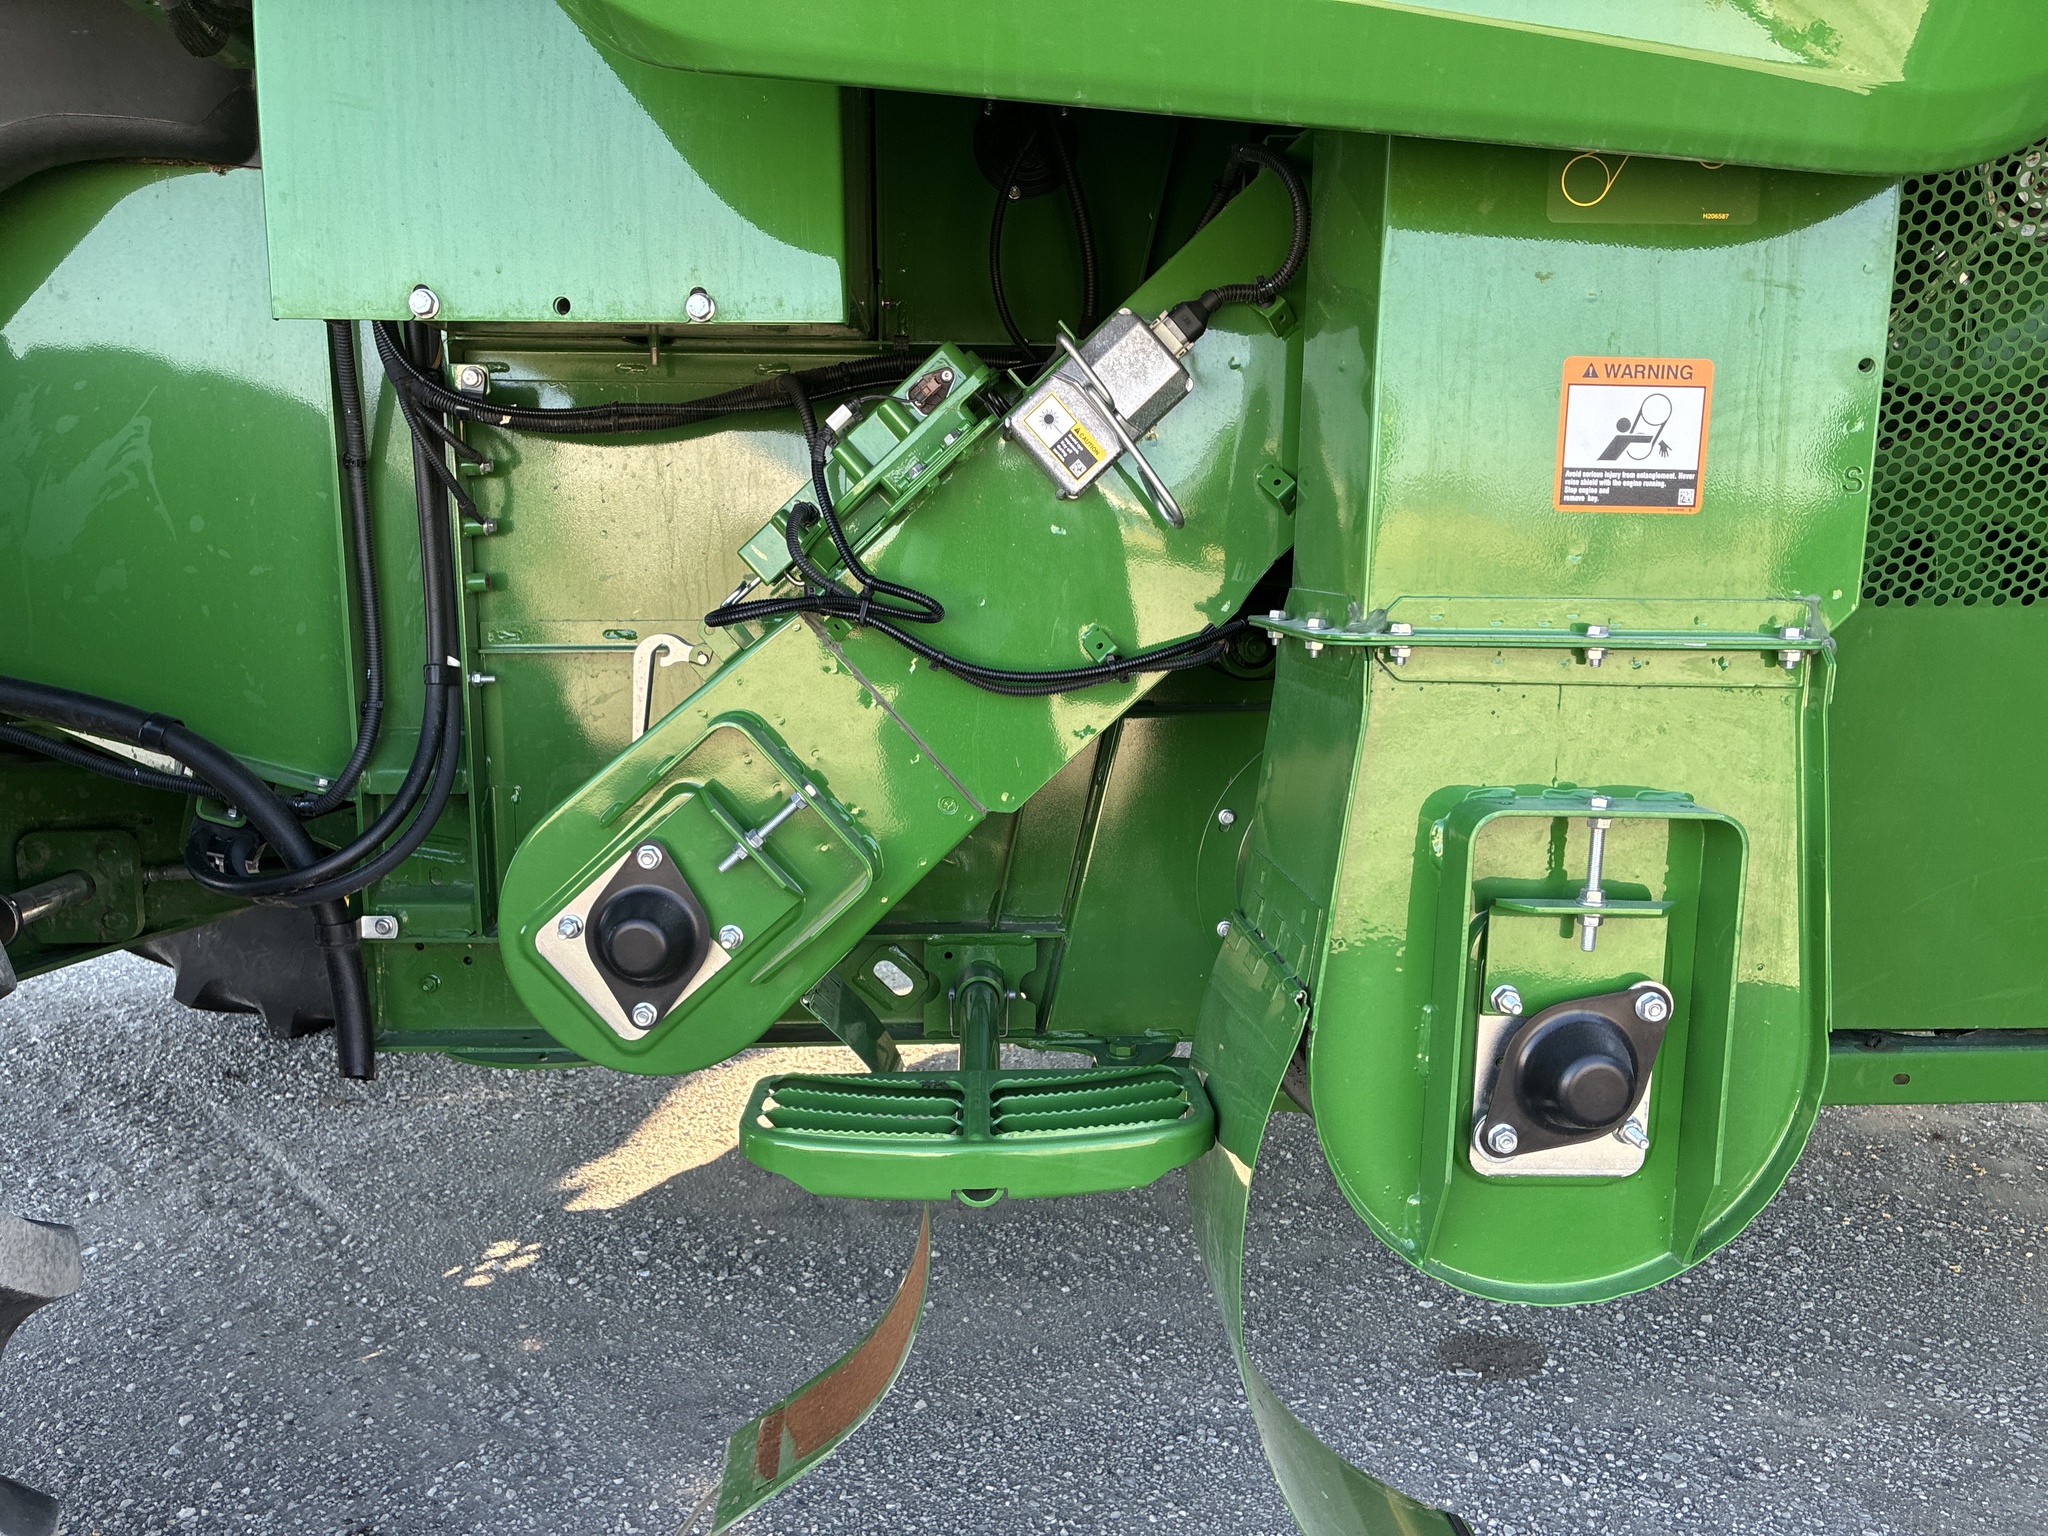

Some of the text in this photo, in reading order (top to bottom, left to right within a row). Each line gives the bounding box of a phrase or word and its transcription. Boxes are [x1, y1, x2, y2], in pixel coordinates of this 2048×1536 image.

[1604, 363, 1694, 380] WARNING
[1079, 432, 1100, 456] CAUTION
[1565, 470, 1581, 478] Avoid
[1604, 471, 1621, 480] injury
[1622, 471, 1636, 479] from
[1636, 472, 1677, 481] entanglement.
[1678, 472, 1696, 480] Never
[1612, 479, 1622, 487] the
[1622, 480, 1642, 488] engine
[1643, 480, 1666, 488] running.
[1564, 486, 1577, 494] Stop
[1578, 487, 1598, 495] engine
[1587, 495, 1600, 503] key.
